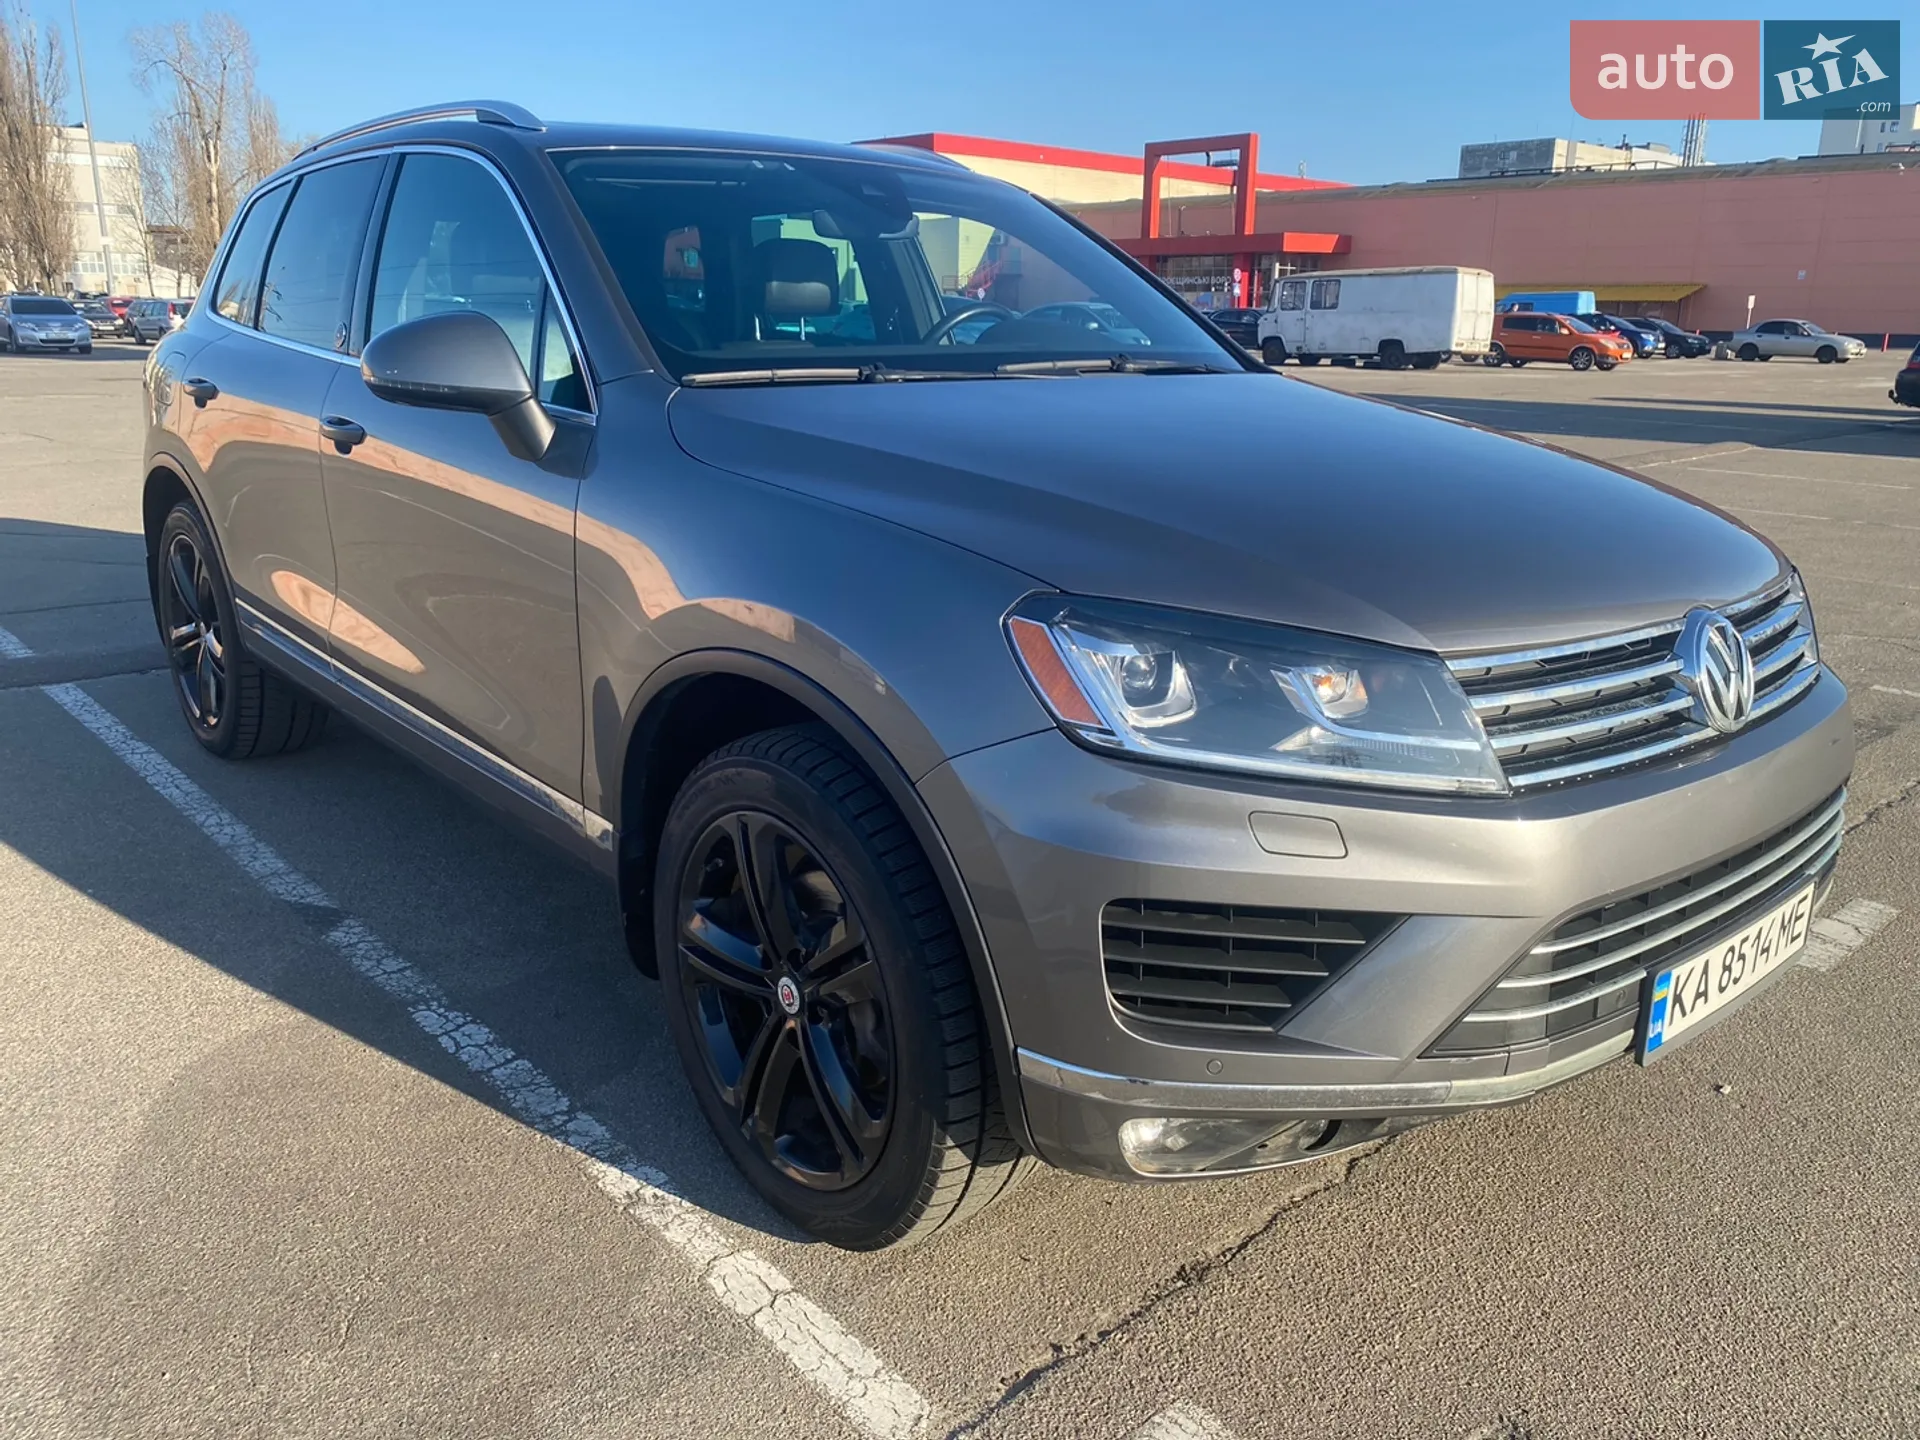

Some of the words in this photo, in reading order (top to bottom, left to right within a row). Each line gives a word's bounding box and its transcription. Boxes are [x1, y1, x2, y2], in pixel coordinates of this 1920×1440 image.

[1210, 275, 1232, 285] ВОРО
[1668, 958, 1711, 1027] KA
[1717, 916, 1776, 995] 8514
[1774, 893, 1809, 957] ME
